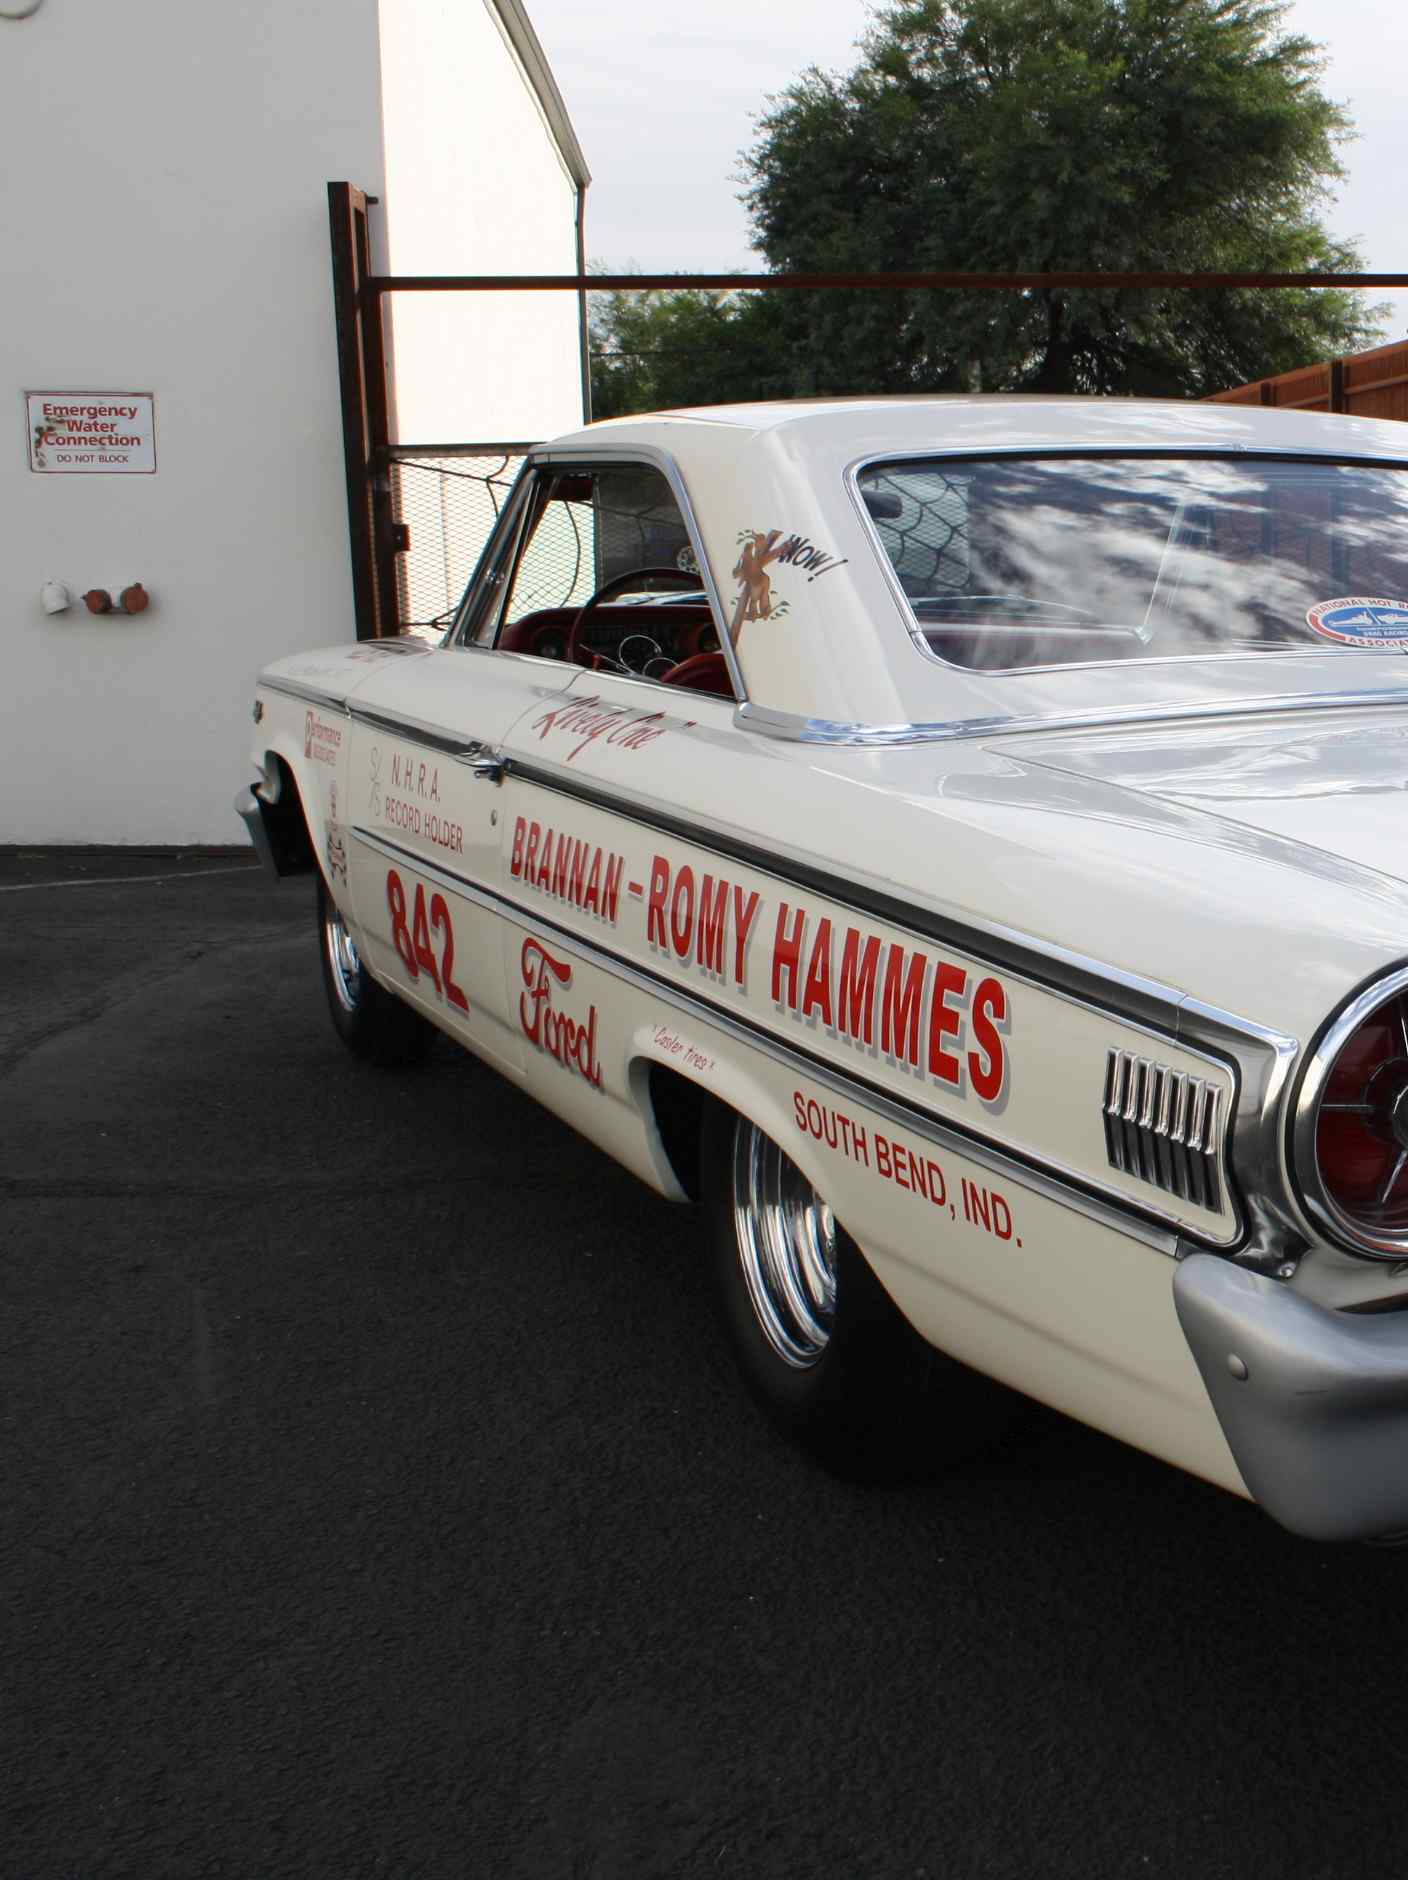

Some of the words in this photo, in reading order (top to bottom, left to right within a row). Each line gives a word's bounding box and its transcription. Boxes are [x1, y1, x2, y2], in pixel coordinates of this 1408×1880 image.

[43, 403, 138, 419] Emergency
[65, 420, 118, 433] Water
[44, 434, 141, 446] Connection
[57, 454, 72, 463] DO
[75, 454, 95, 463] NOT
[98, 454, 129, 463] BLOCK
[778, 534, 848, 582] WOW!
[385, 796, 421, 834] RECORD
[424, 812, 463, 858] HOLDER
[387, 869, 470, 1015] 842
[520, 937, 604, 1088] Ford
[770, 902, 1010, 1110] HAMMES
[793, 1091, 870, 1168] SOUTH
[874, 1134, 956, 1221] BEND,
[962, 1177, 1024, 1249] IND.
